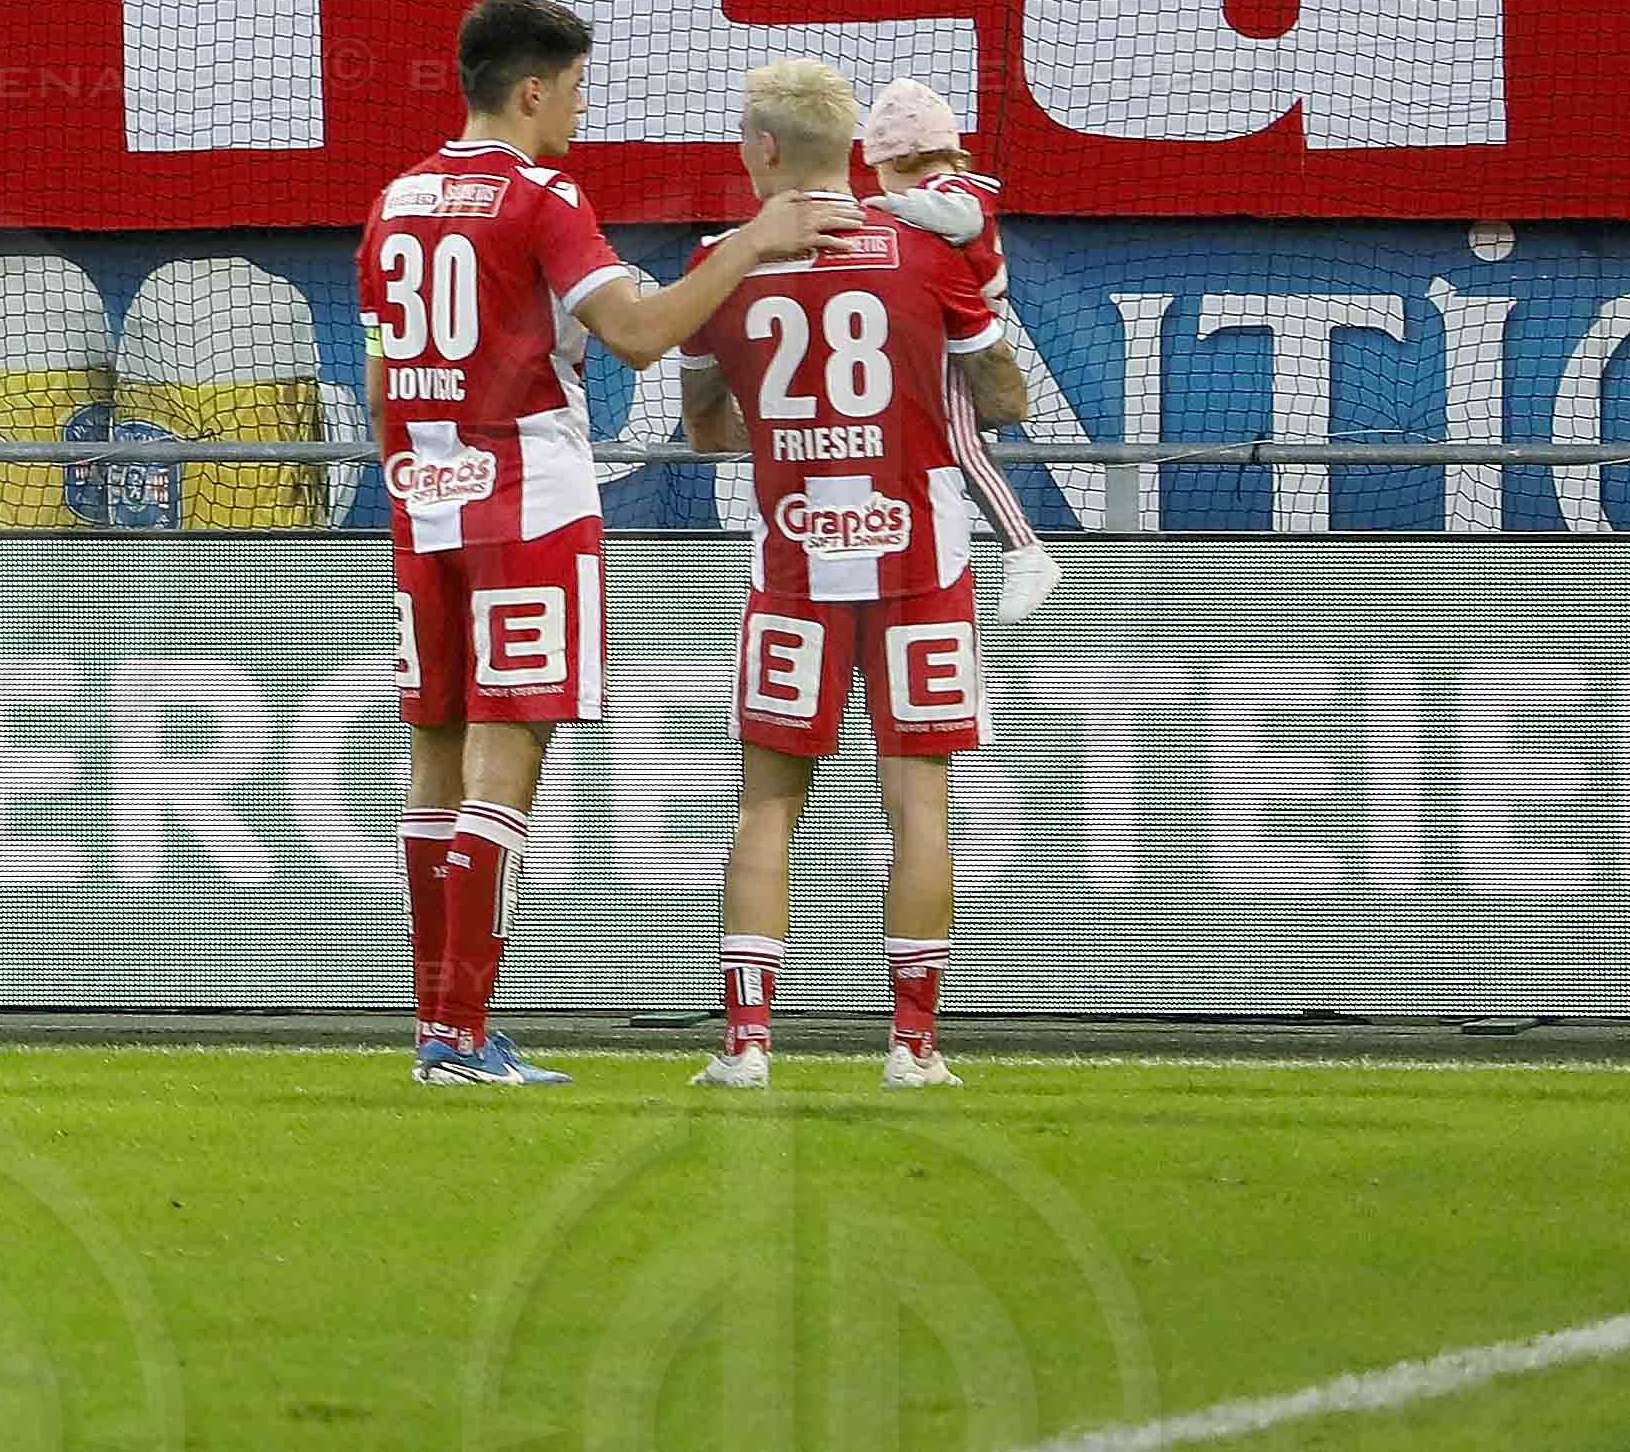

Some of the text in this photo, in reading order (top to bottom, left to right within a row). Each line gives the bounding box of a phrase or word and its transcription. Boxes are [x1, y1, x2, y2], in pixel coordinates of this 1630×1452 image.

[379, 234, 479, 361] 30
[746, 290, 895, 420] 28
[773, 424, 884, 461] FRIESER
